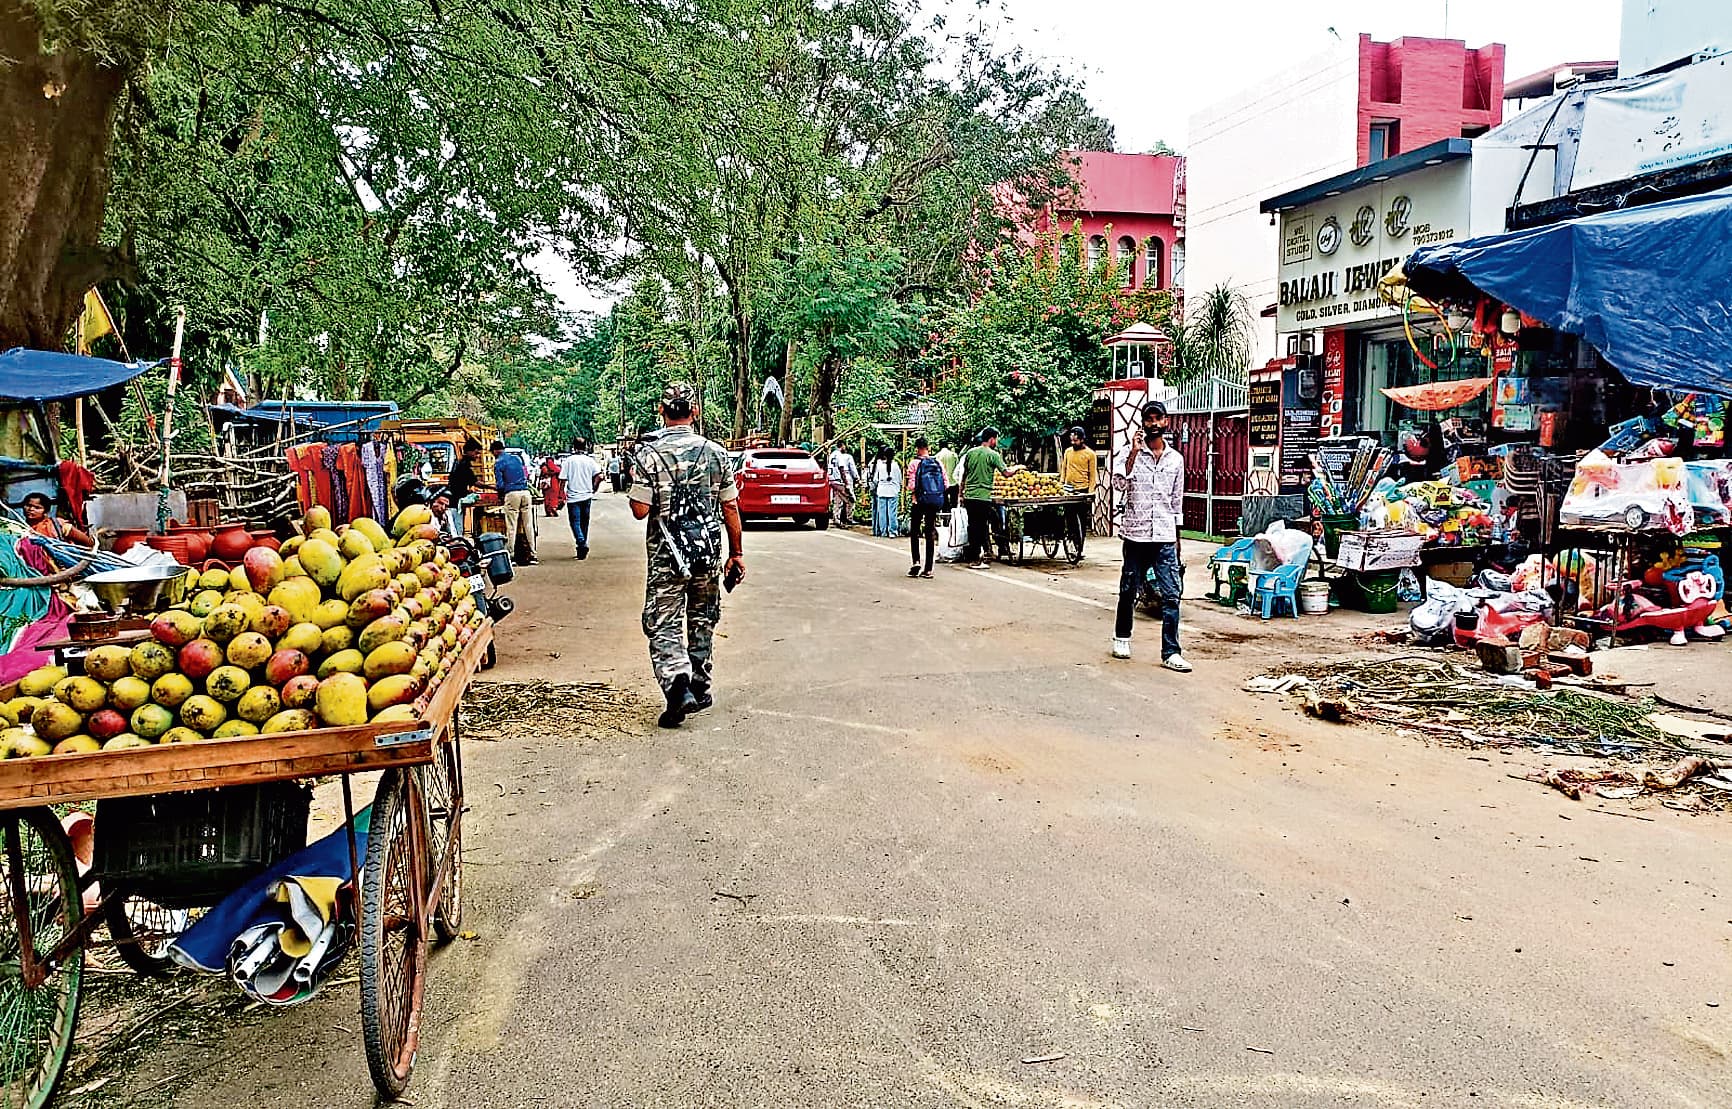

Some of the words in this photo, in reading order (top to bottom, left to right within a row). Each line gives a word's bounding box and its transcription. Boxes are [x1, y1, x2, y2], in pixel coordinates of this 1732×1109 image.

[1413, 223, 1431, 235] MOB
[1286, 243, 1310, 256] STUDIO
[1280, 271, 1336, 306] BALAJI
